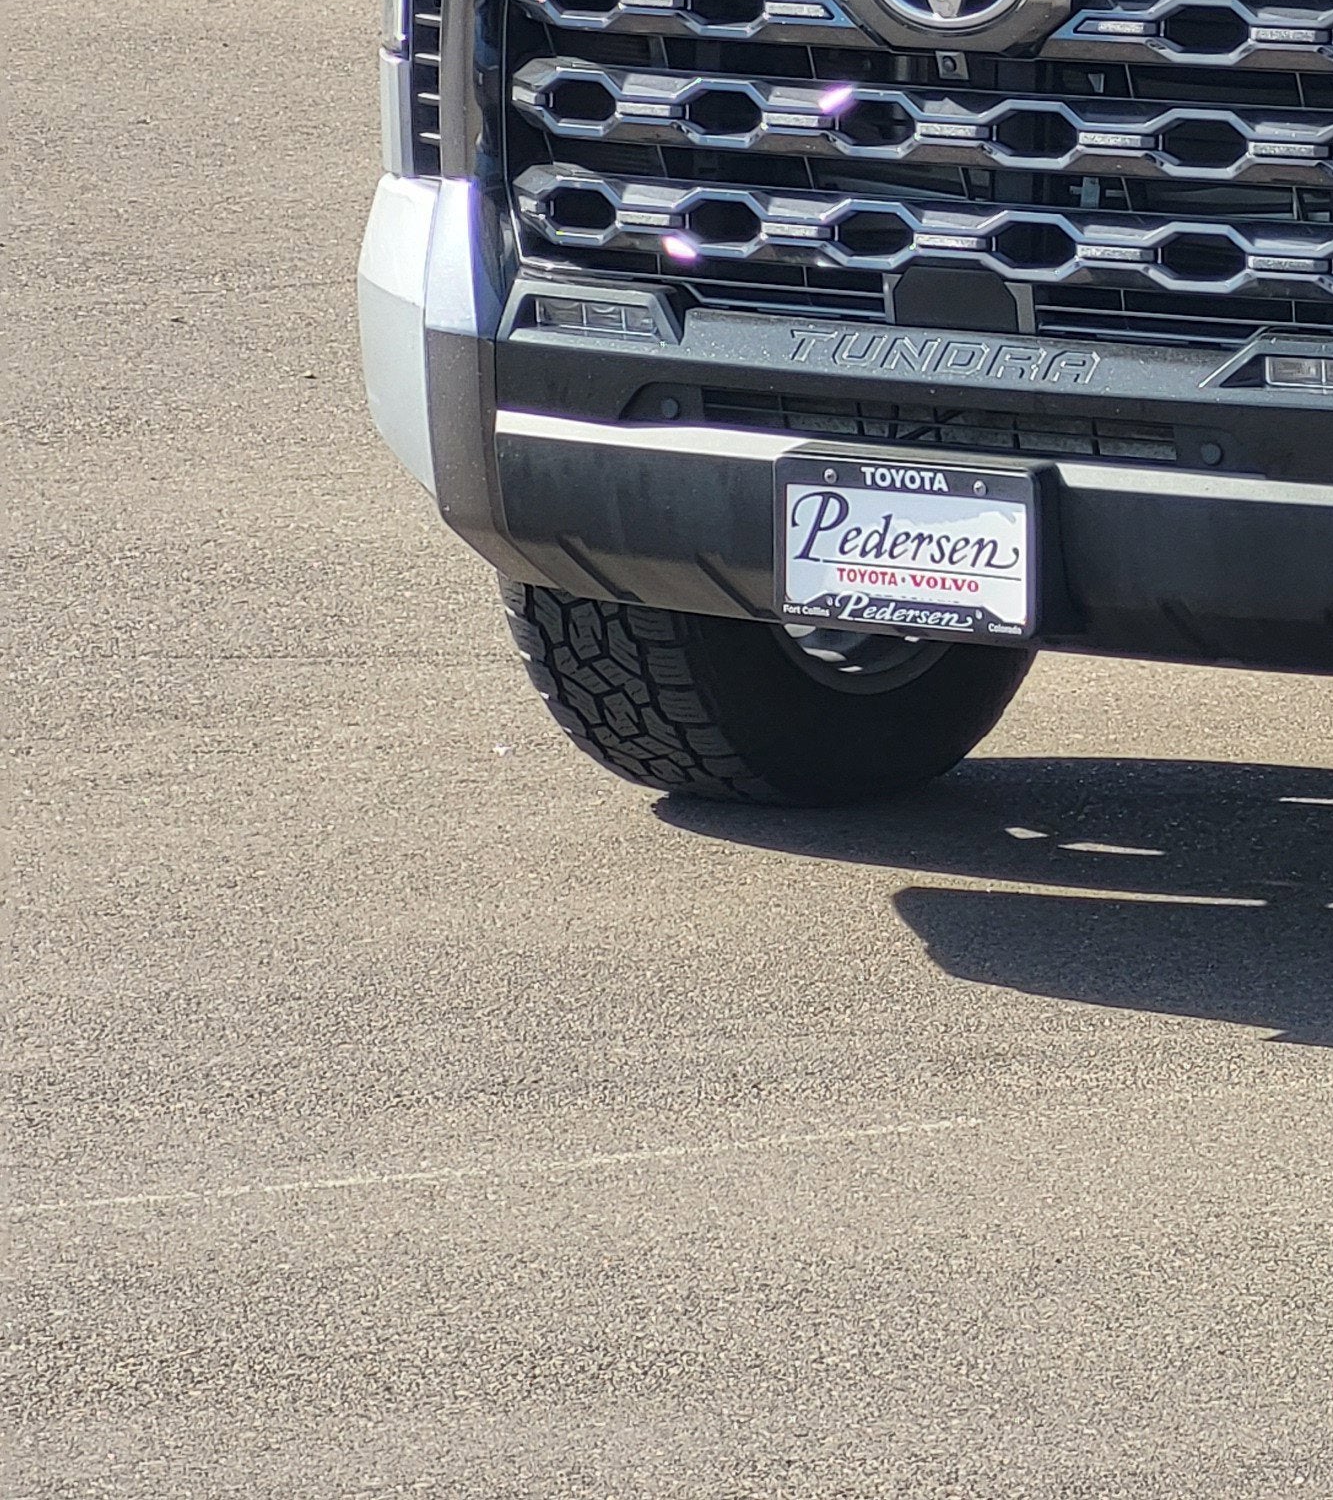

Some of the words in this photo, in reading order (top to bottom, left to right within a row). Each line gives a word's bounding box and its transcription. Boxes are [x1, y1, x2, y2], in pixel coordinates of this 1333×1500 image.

[789, 328, 1101, 386] TUNDRA
[861, 466, 949, 492] TOYOTA
[791, 490, 1020, 570] Pedersen
[837, 566, 899, 587] TOYOTA
[909, 574, 980, 593] VOLVO
[835, 591, 974, 627] Pedersen
